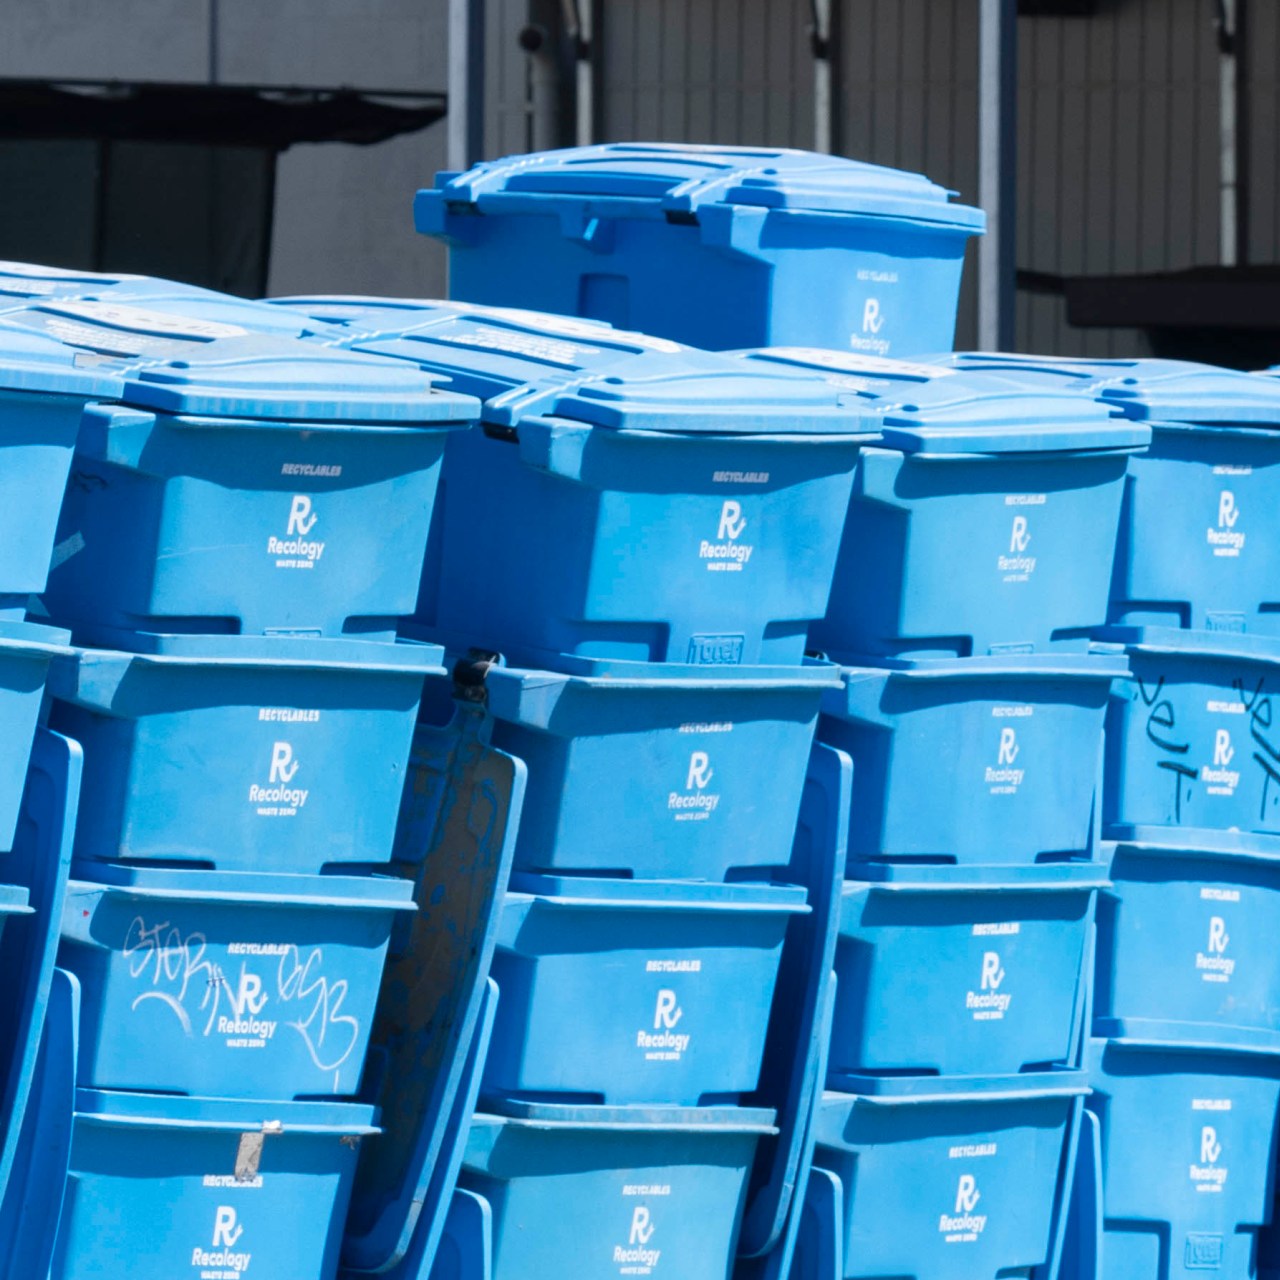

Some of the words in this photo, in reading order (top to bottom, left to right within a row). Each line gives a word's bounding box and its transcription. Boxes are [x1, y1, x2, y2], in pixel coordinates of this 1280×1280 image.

[282, 464, 341, 476] RECYCLABLES
[713, 472, 769, 483] RECYCLABLES
[267, 536, 325, 561] Recology
[700, 539, 752, 563] Recology
[998, 556, 1036, 574] Recology
[259, 708, 321, 721] RECYCLABLES
[678, 722, 733, 734] RECYCLABLES
[985, 767, 1024, 785] Recology
[249, 784, 308, 808] Recology
[668, 792, 719, 812] Recology
[228, 943, 289, 955] RECYCLABLES
[646, 960, 701, 972] RECYCLABLES
[966, 990, 1010, 1011] Recology
[218, 1015, 277, 1039] Recology
[637, 1030, 689, 1052] Recology
[623, 1185, 670, 1195] RECYCLABLES
[939, 1212, 986, 1234] Recology
[192, 1248, 251, 1272] Recology
[614, 1245, 660, 1266] Recology
